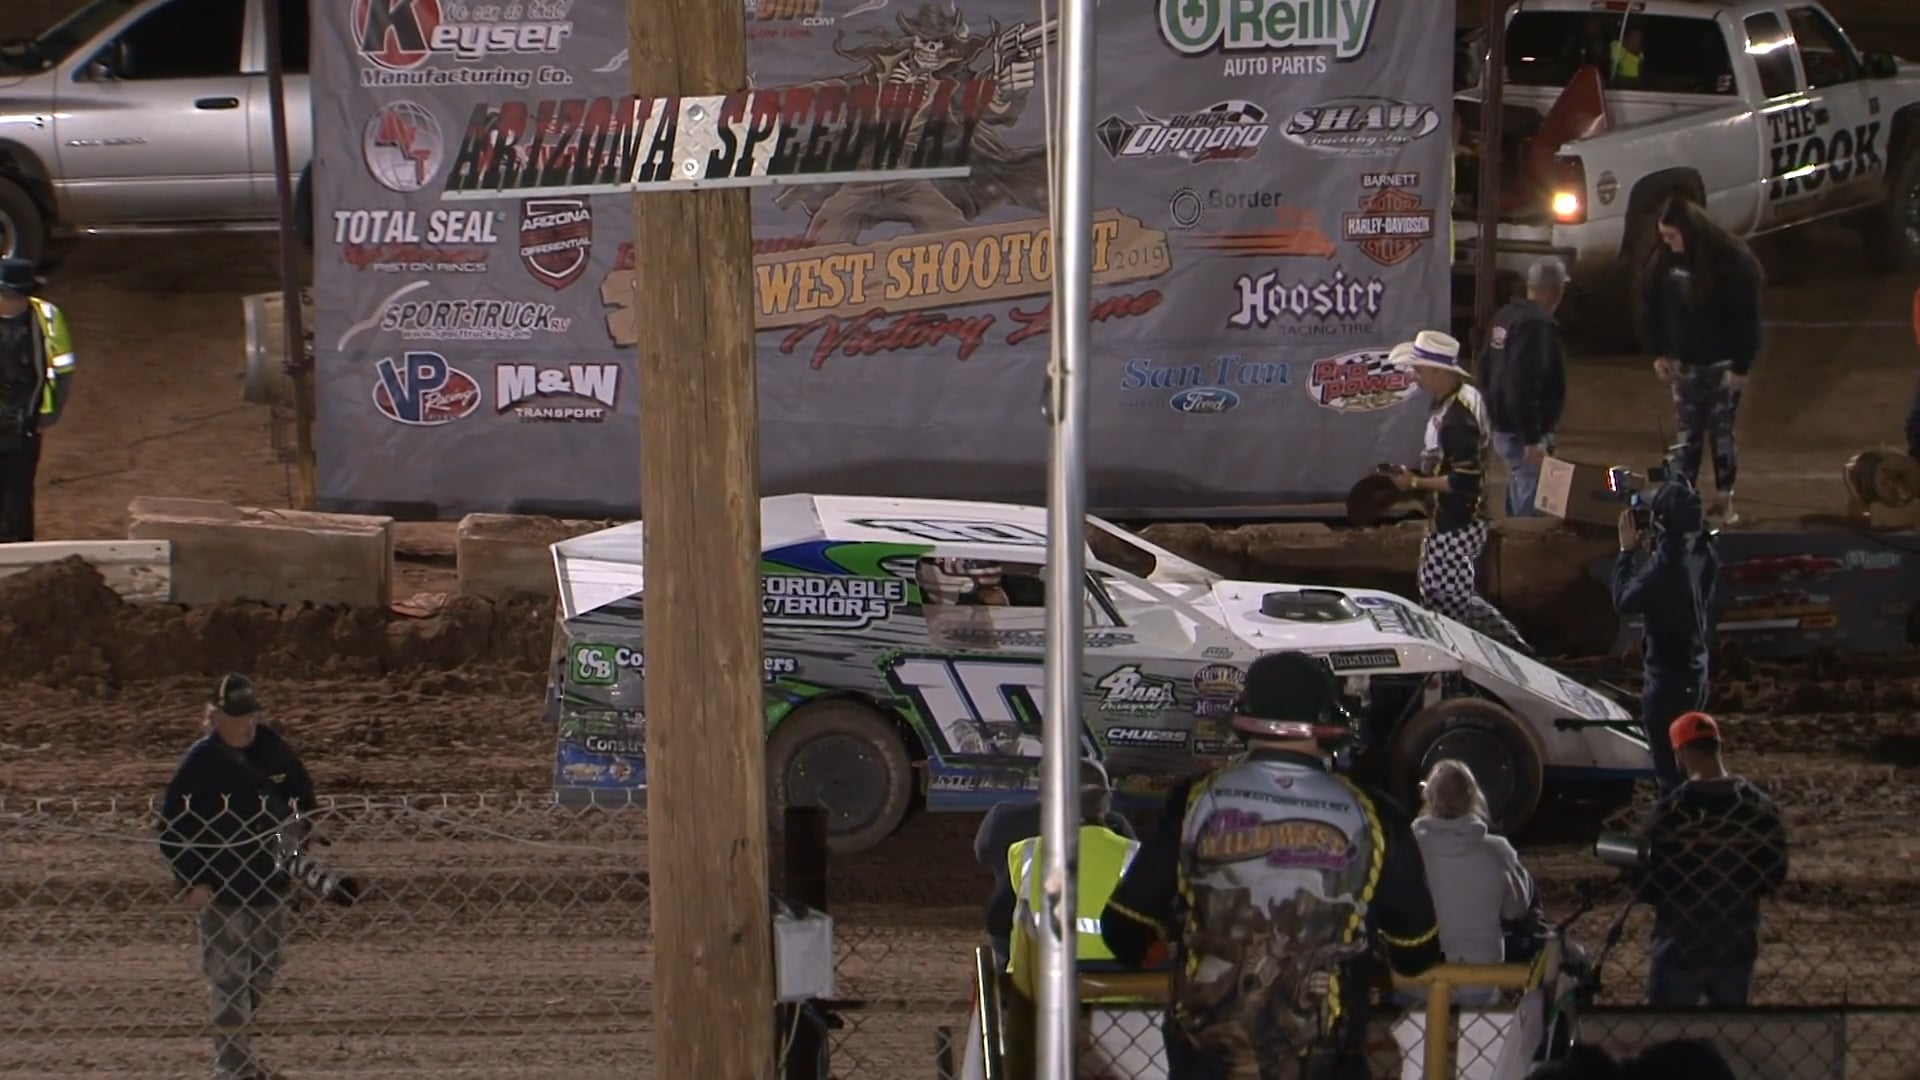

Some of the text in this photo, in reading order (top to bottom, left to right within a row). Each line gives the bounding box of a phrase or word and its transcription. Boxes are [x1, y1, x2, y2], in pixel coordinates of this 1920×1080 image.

[358, 0, 572, 61] Keyser
[1164, 0, 1378, 52] OReilly
[361, 67, 572, 87] Manufacturing Co.
[1223, 55, 1327, 77] AUTO PARTS
[445, 79, 996, 190] ARIZONA SPEEDWAY
[1287, 103, 1433, 134] SHAW
[1767, 106, 1815, 143] THE
[1121, 123, 1269, 155] DIAMOND
[1770, 122, 1881, 199] HOOK
[1363, 174, 1417, 187] BARNETT
[1208, 189, 1283, 211] Border
[333, 209, 498, 243] TOTAL SEAL
[521, 209, 591, 231] ARIZONA
[1348, 217, 1430, 235] HARLEY-DAVIDSON
[756, 220, 1166, 315] WEST SHOOTOT 2019
[1229, 270, 1383, 326] Hoosier
[1341, 323, 1373, 335] TIRE
[377, 352, 447, 422] VP
[497, 365, 620, 409] M&W
[1121, 354, 1293, 390] San Tan
[516, 408, 603, 418] TRANSPORT
[1182, 392, 1226, 411] Ford
